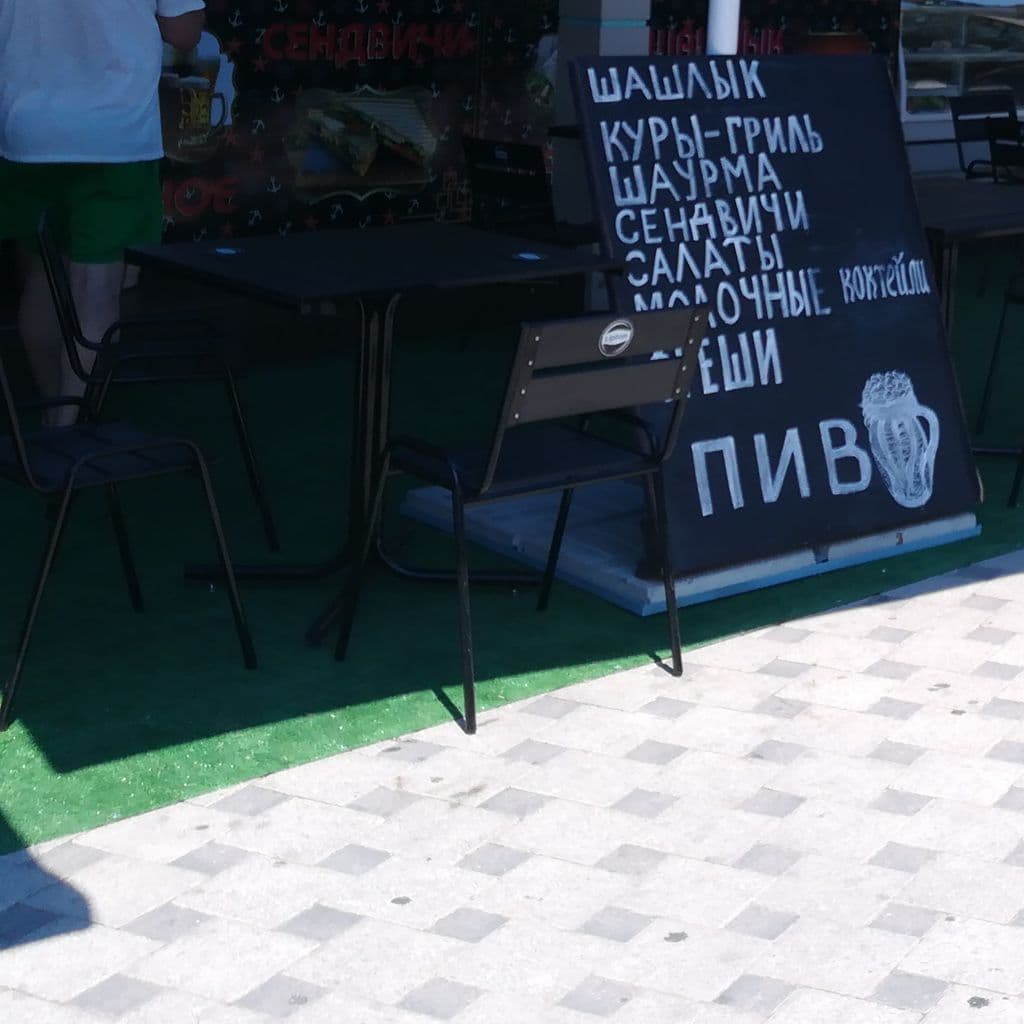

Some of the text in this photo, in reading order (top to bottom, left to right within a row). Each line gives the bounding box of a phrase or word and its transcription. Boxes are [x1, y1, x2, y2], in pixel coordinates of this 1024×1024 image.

[587, 58, 768, 103] ШАШЛЫК
[600, 113, 825, 163] КУРЫ-ГРИЛЬ
[609, 152, 783, 207] ШАУРМА
[615, 191, 809, 245] СЕНДВИЧИ
[626, 235, 783, 287] САЛАТЫ
